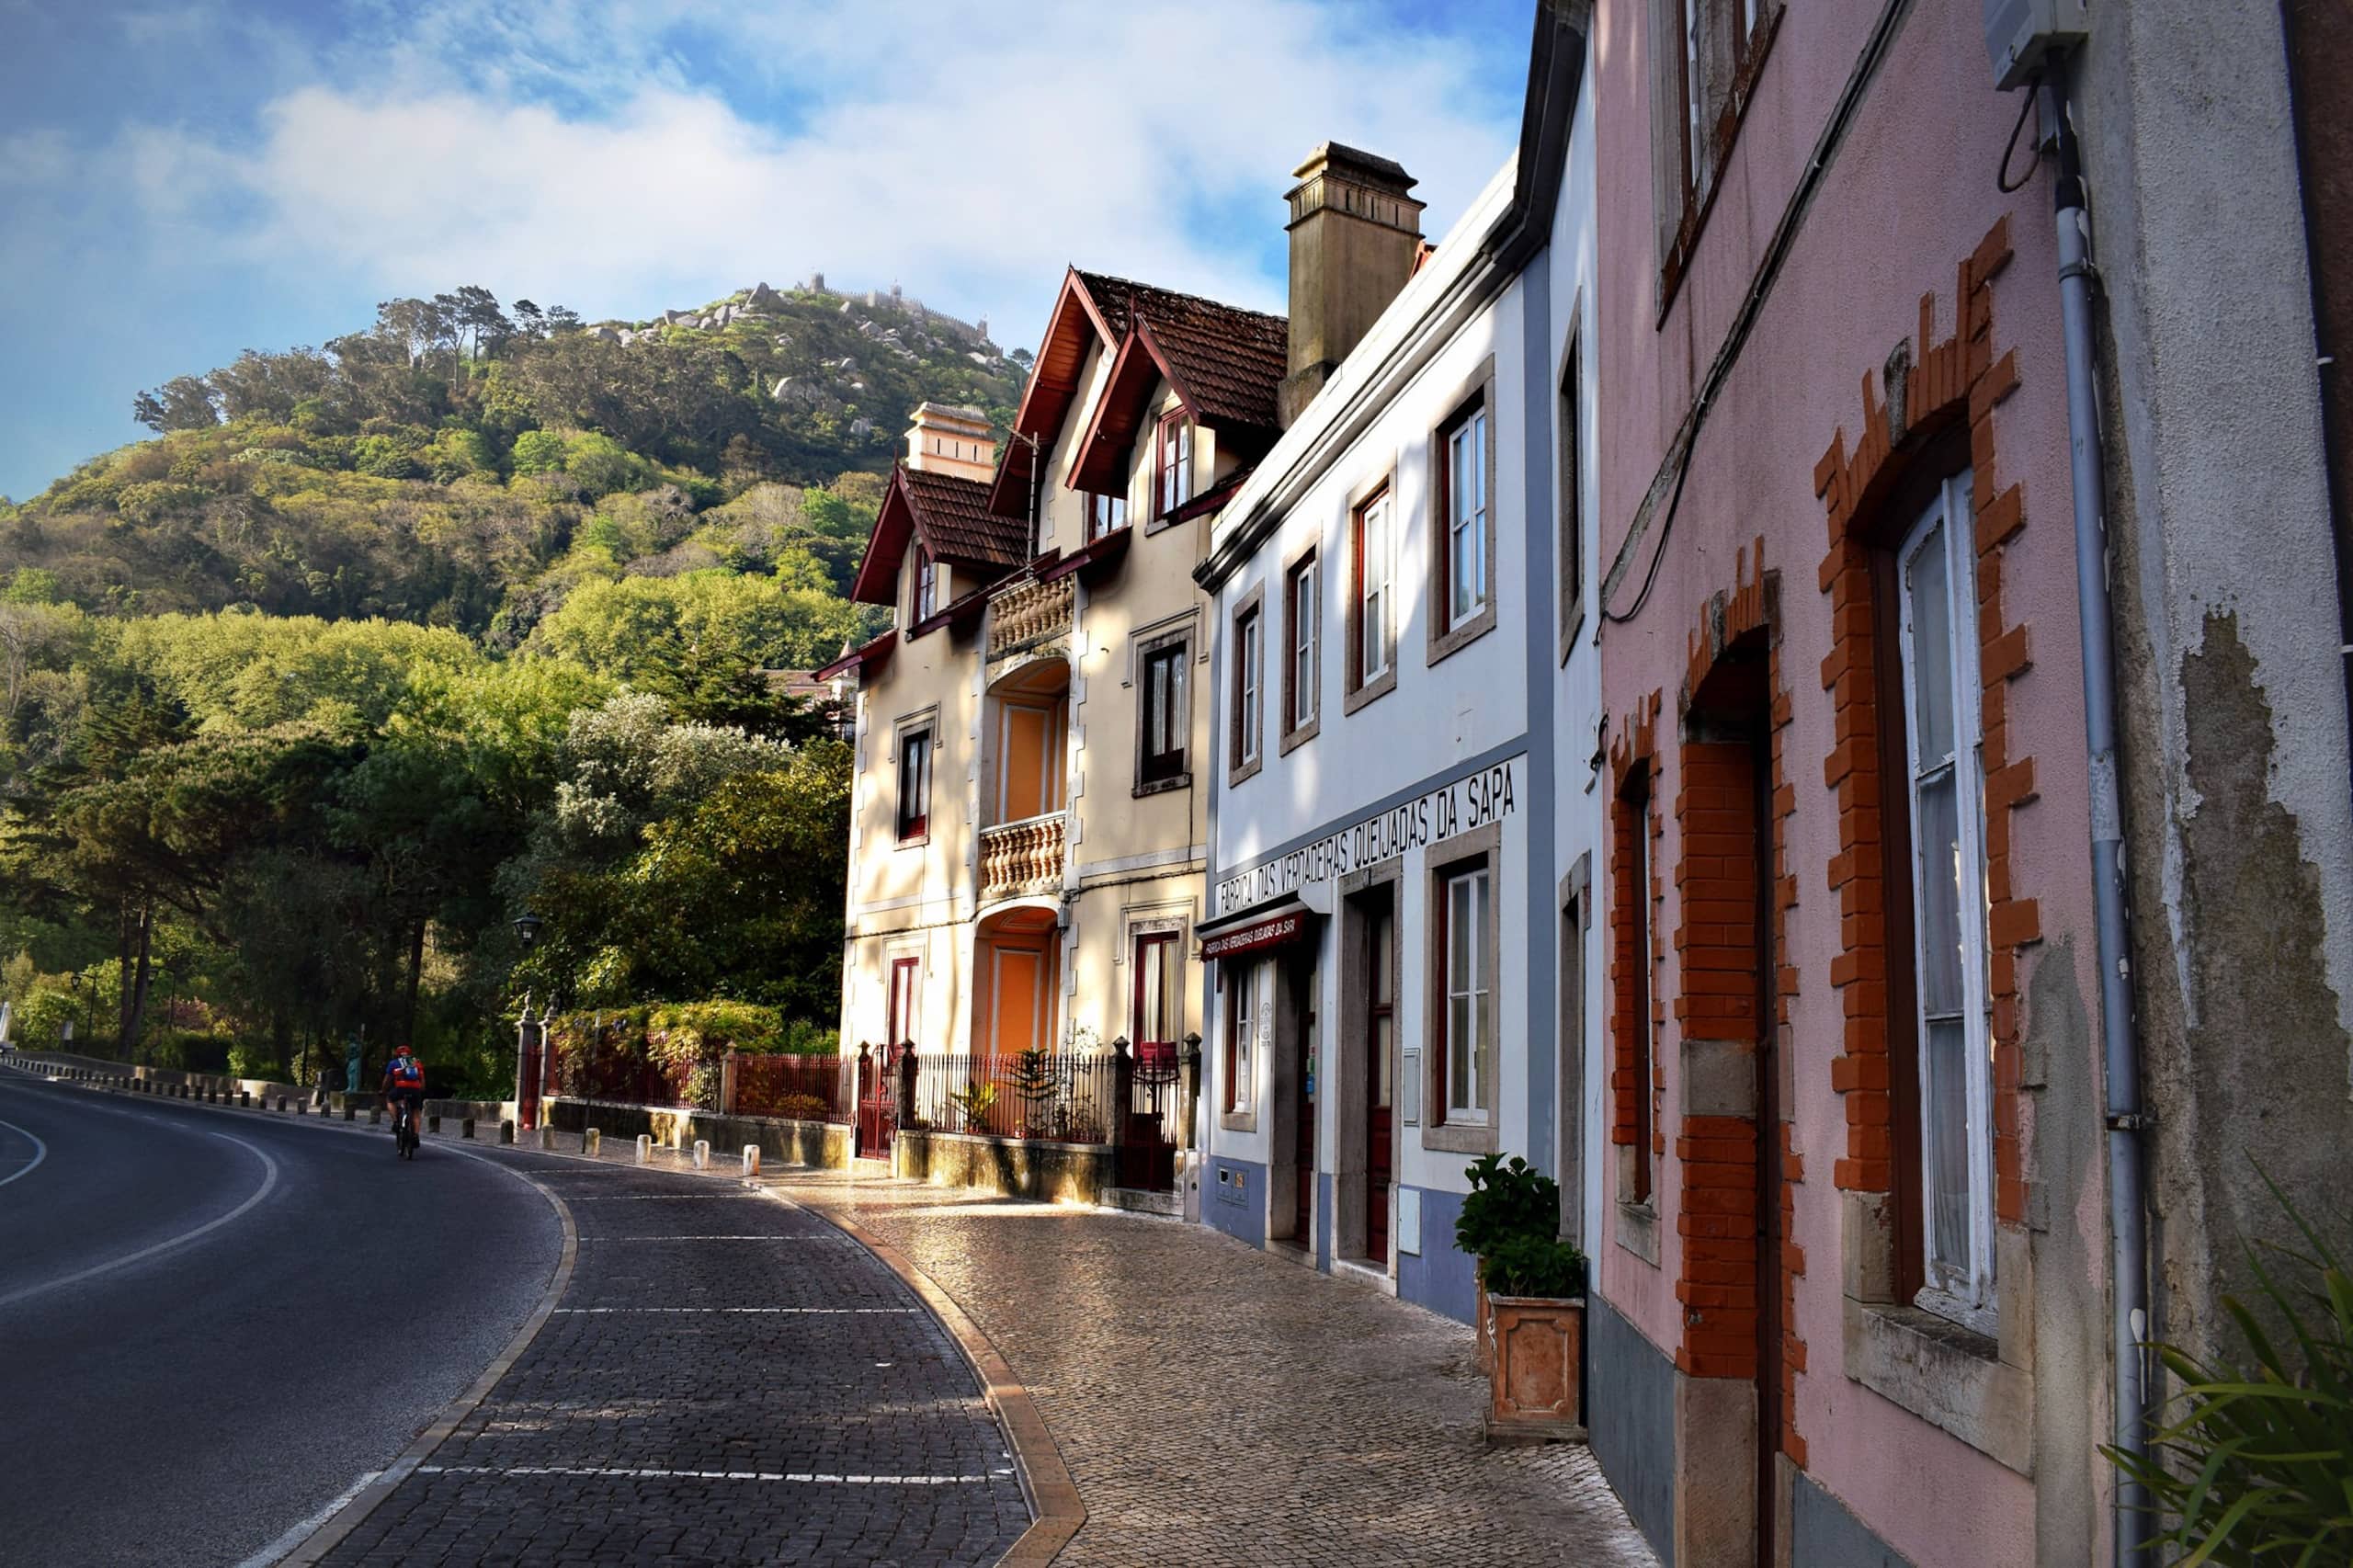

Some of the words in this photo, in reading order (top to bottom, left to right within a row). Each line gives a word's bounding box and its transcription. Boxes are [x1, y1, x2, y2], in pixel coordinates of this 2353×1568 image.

[1222, 875, 1252, 915] FABRICA
[1258, 863, 1275, 902] DAS
[1281, 833, 1347, 892] VERDADEIRAS
[1354, 799, 1427, 869] QUEIJADAS
[1437, 786, 1458, 840] DA
[1468, 764, 1515, 827] SAPA
